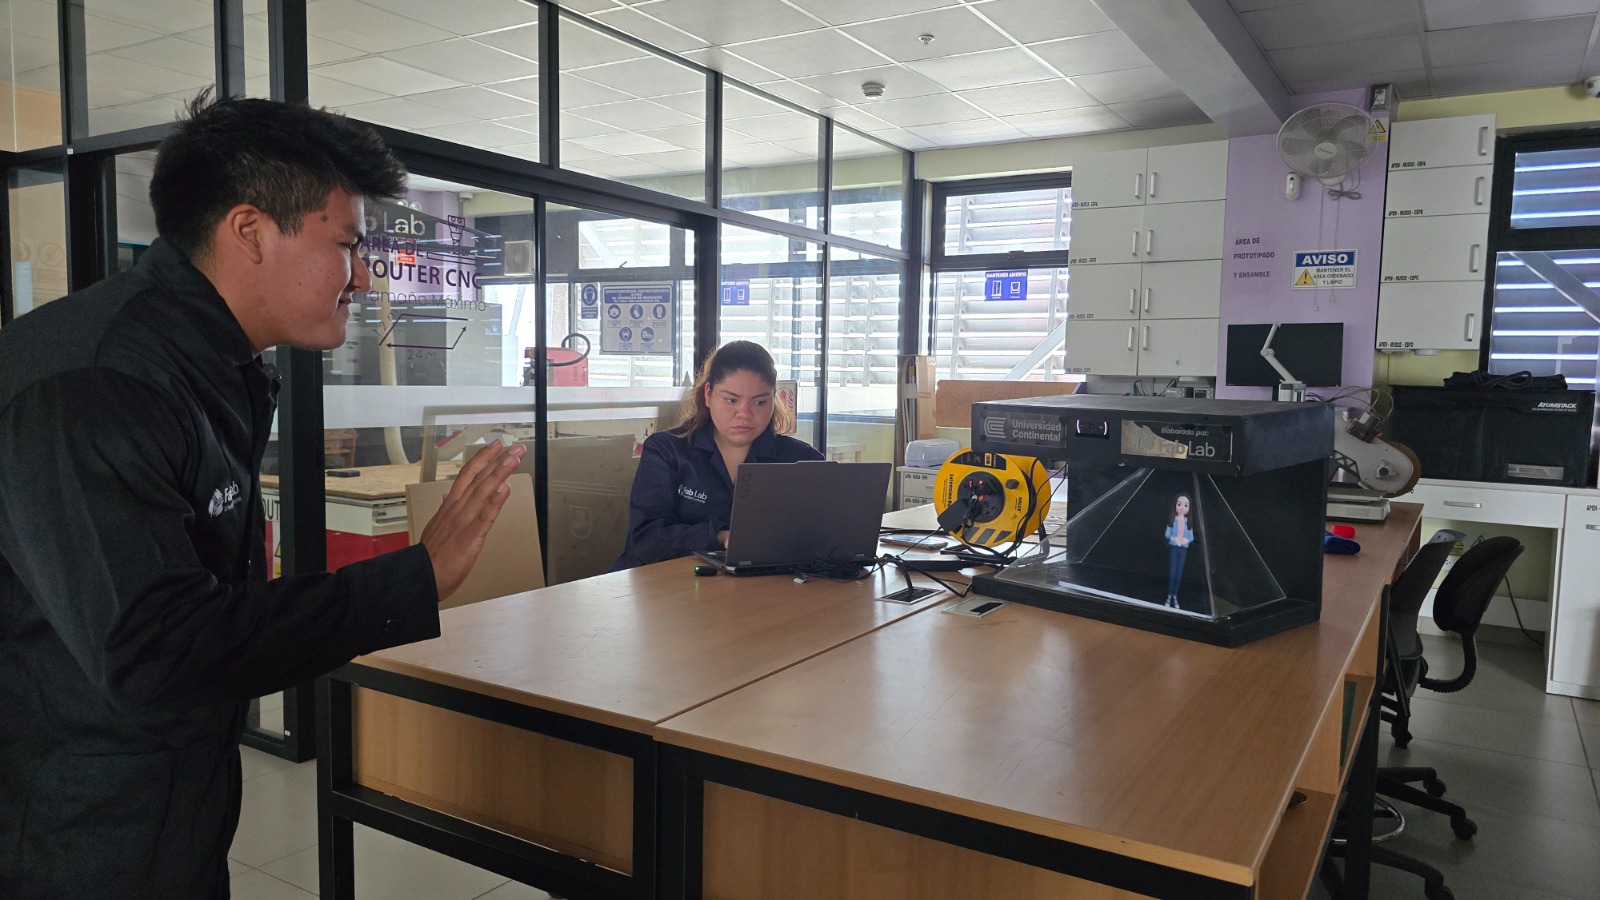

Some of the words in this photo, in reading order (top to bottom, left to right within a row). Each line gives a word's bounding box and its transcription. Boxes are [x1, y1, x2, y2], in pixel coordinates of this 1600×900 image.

[384, 211, 426, 237] Lab
[405, 239, 424, 257] DE
[1233, 252, 1275, 260] PROTOTIPADO
[1302, 254, 1348, 265] AVISO
[445, 268, 482, 289] CNC
[432, 293, 487, 312] Máximo
[1012, 420, 1062, 432] Universidad
[1161, 427, 1194, 436] Elaborado
[1012, 430, 1061, 442] Continental
[1188, 440, 1215, 457] Lab
[694, 490, 707, 500] Lab
